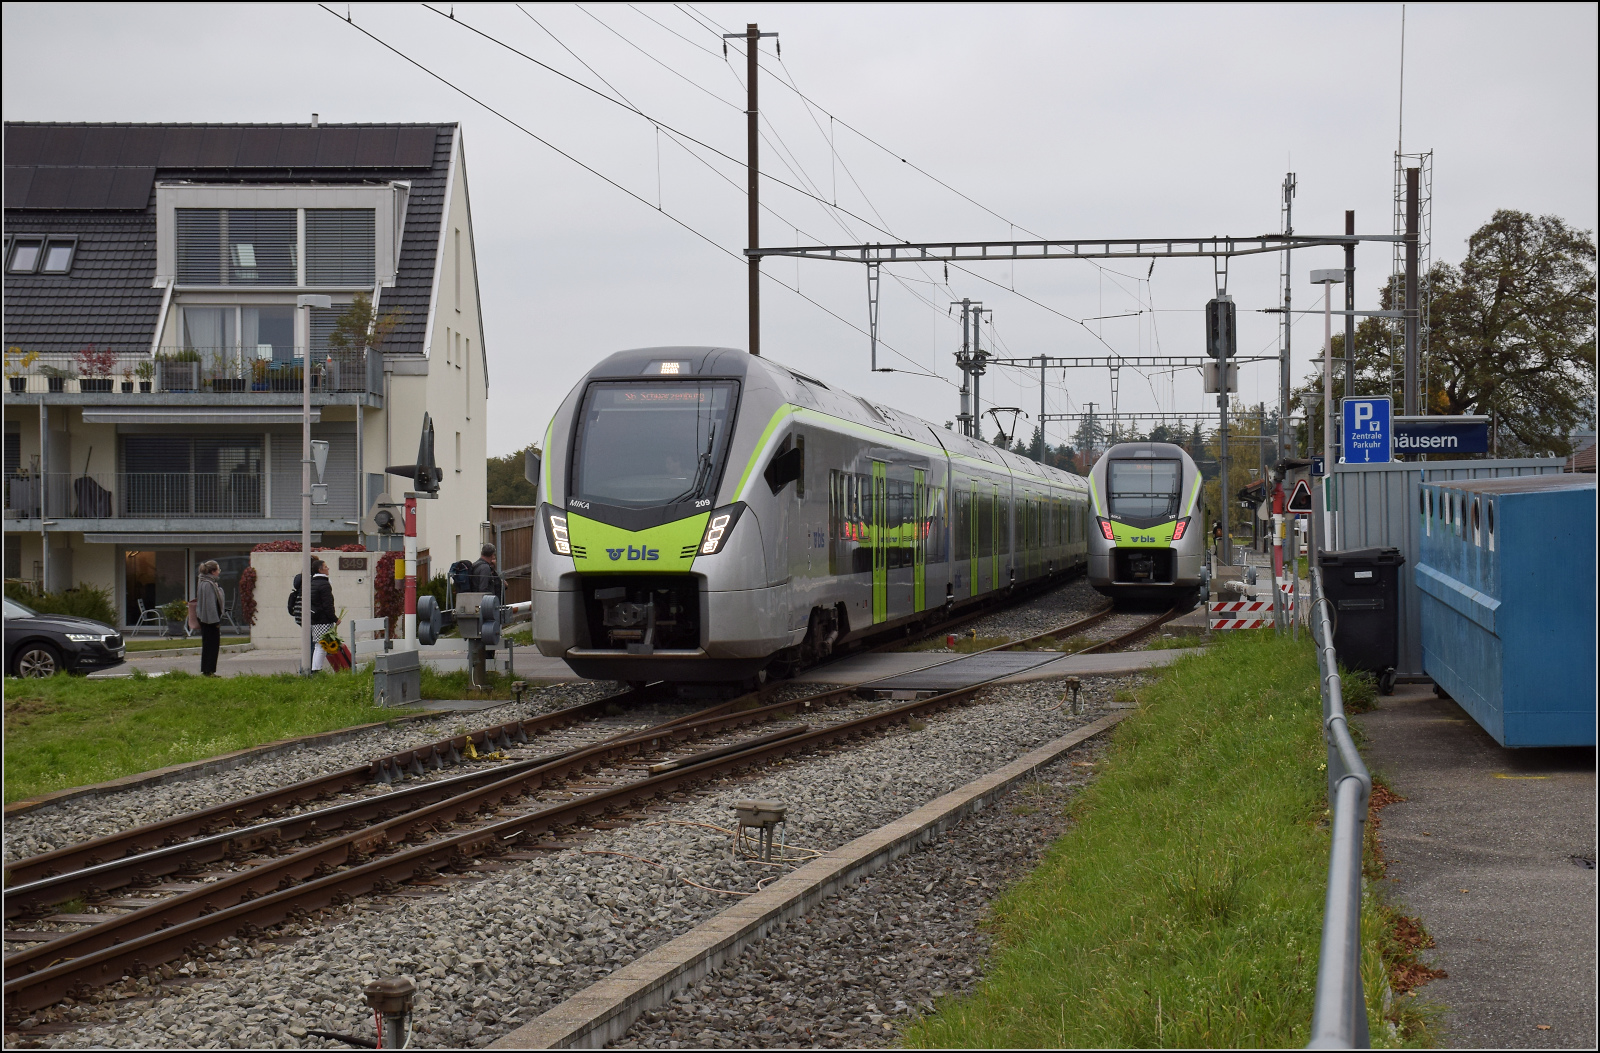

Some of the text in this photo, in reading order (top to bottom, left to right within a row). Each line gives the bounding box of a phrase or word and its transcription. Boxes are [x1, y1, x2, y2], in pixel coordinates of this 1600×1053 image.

[1355, 403, 1373, 430] P
[1352, 432, 1382, 440] Zentrale
[1353, 441, 1381, 449] Parkuhr
[1319, 461, 1324, 473] 1
[569, 500, 590, 510] MIKA
[695, 499, 711, 508] 209
[1140, 535, 1156, 543] bls
[627, 545, 660, 561] bls
[343, 558, 364, 569] 349
